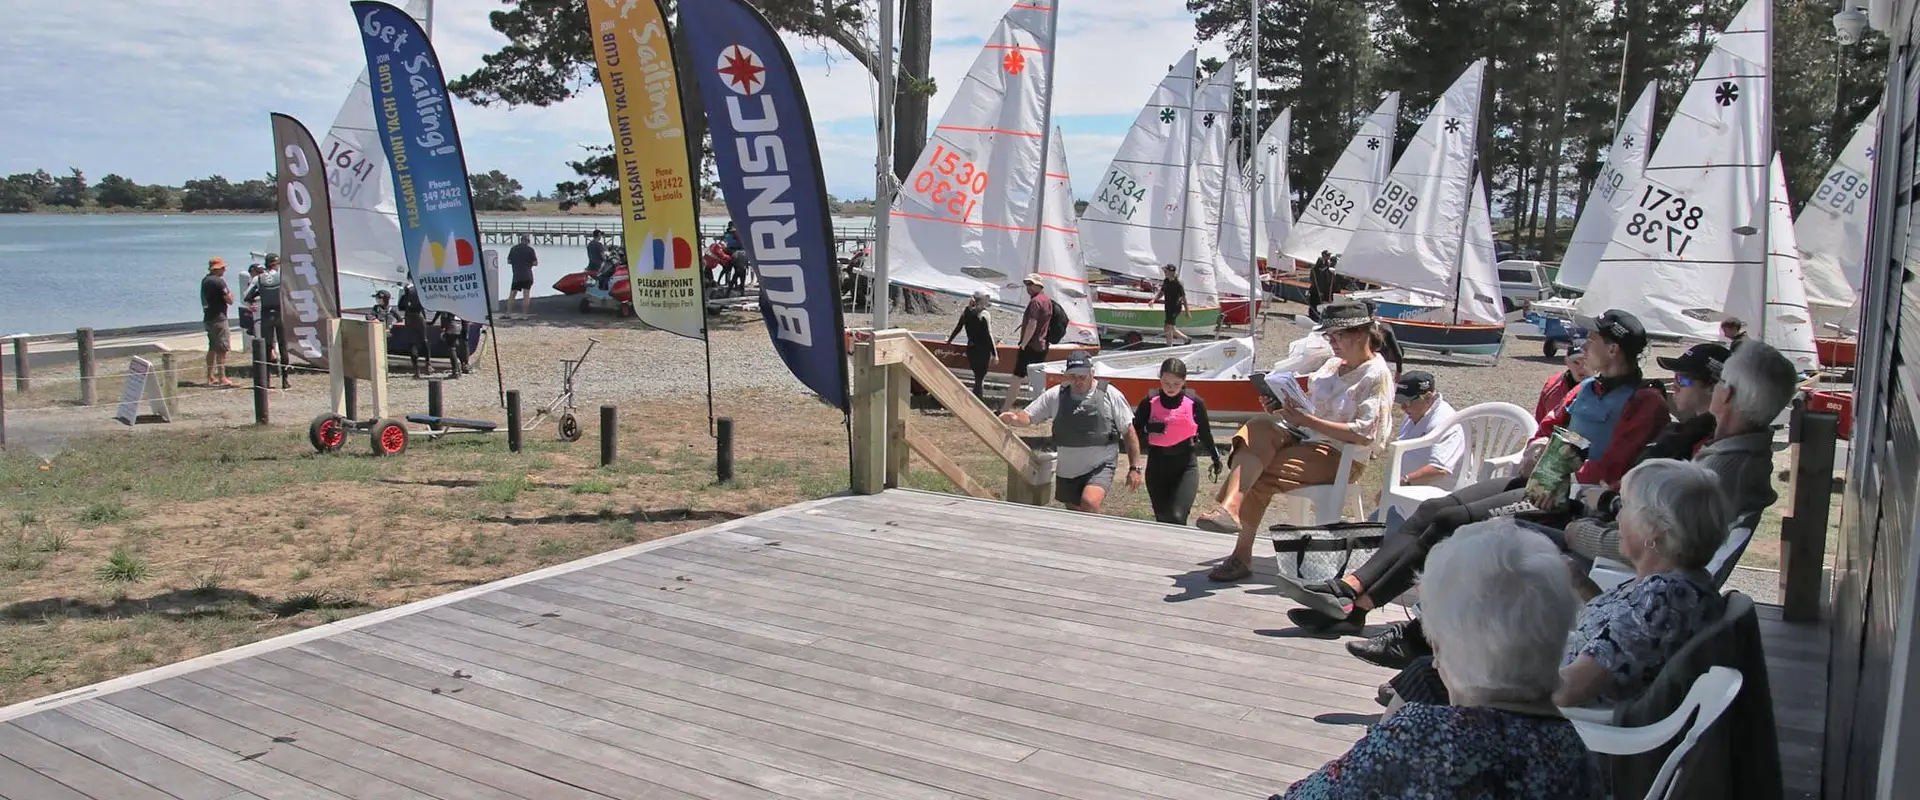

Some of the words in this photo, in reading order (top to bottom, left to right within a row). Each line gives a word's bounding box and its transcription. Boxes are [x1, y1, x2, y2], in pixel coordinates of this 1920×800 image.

[363, 9, 408, 52] Get
[603, 33, 620, 67] CLUB
[378, 64, 393, 93] CLUB
[611, 71, 628, 112] YACHT
[383, 97, 401, 133] YACHT
[618, 115, 636, 154] POINT
[327, 141, 375, 182] 1641
[390, 135, 409, 174] POINT
[929, 143, 989, 196] 1530
[400, 176, 420, 229] PLEASANT
[626, 157, 646, 221] PLEASANT
[1108, 170, 1147, 203] 1434
[1320, 184, 1355, 214] 1632
[1381, 180, 1418, 212] 1819
[1827, 170, 1870, 200] 499
[1638, 185, 1704, 230] 1738
[419, 275, 452, 285] PLEASANT
[454, 273, 477, 284] POINT
[421, 283, 449, 293] YACHT
[454, 281, 478, 292] CLUB
[638, 278, 669, 288] PLEASANT
[670, 278, 693, 287] POINT
[639, 288, 667, 298] YACHT
[669, 288, 694, 298] CLUB
